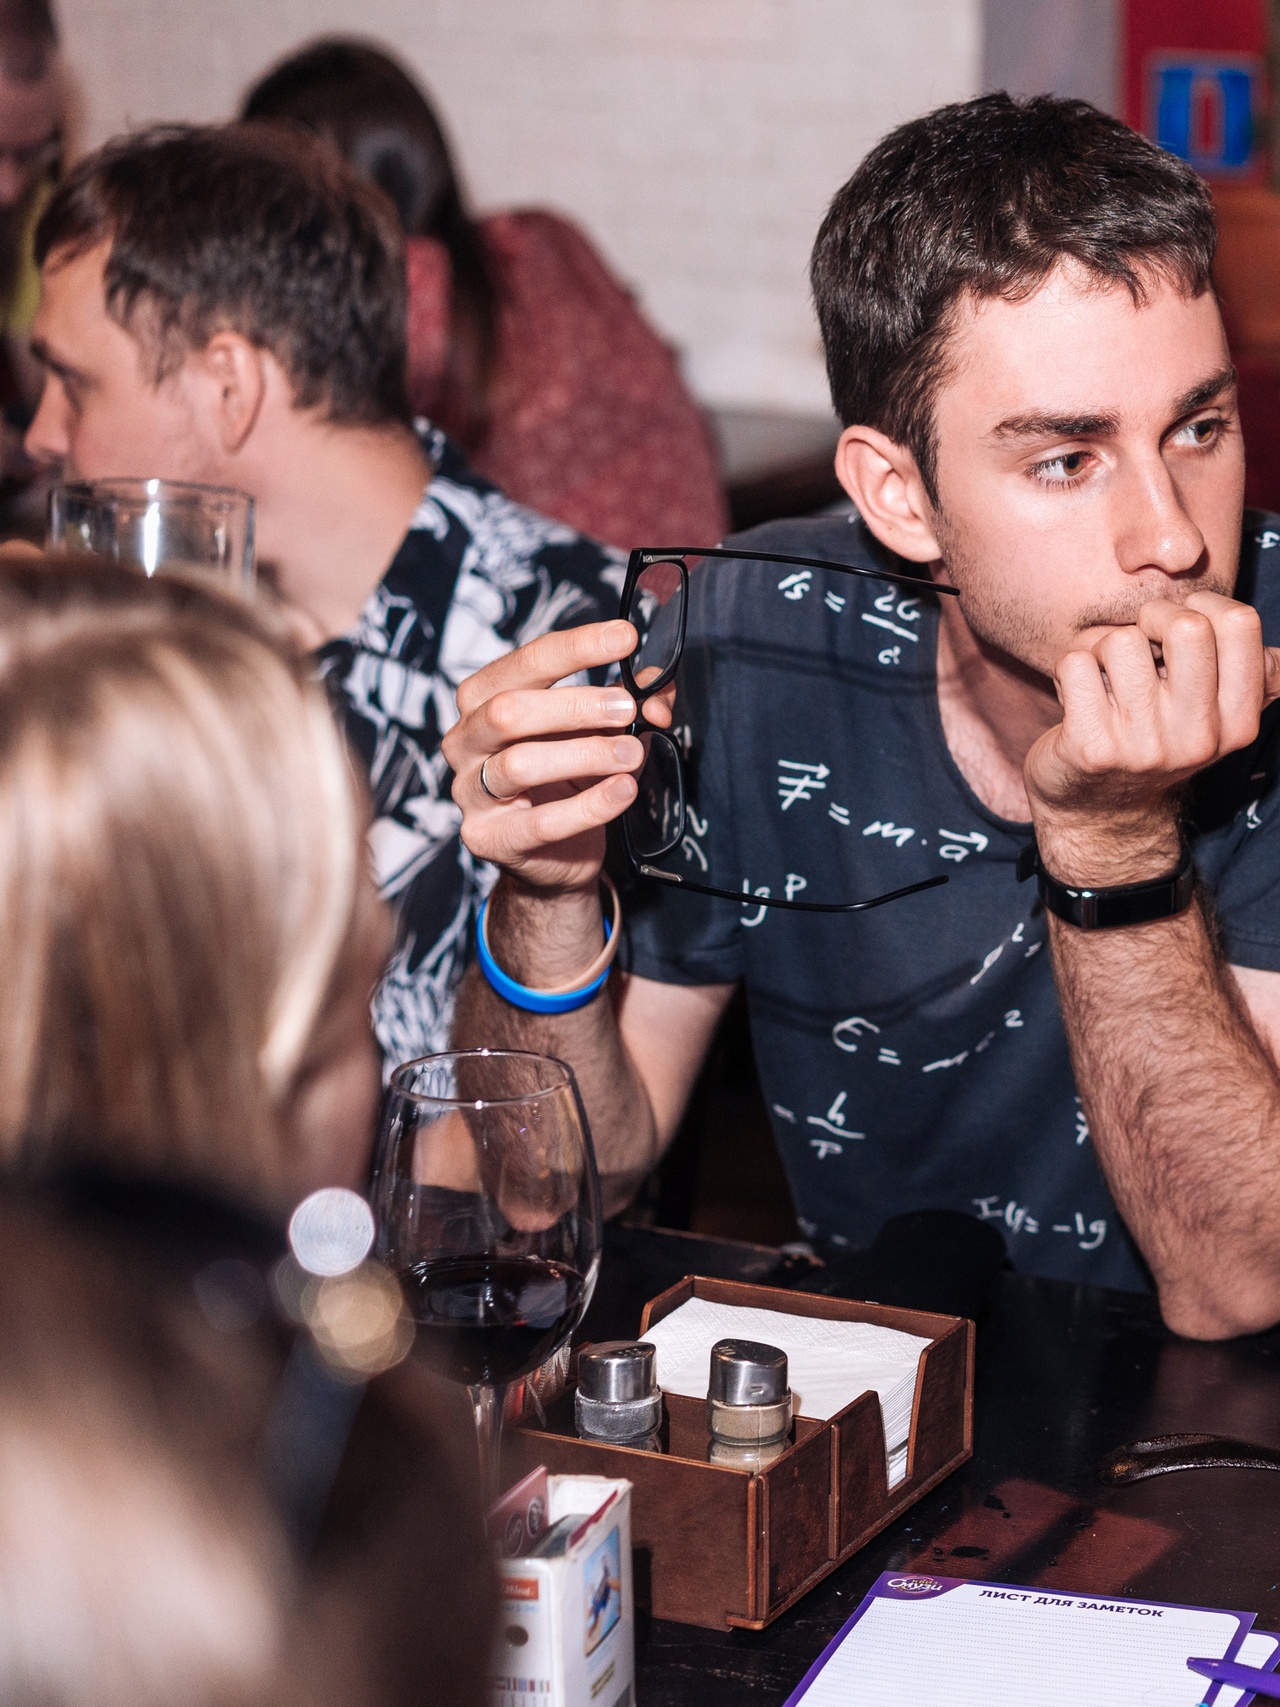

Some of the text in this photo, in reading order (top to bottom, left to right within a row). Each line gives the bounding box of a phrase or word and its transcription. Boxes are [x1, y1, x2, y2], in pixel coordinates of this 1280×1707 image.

[979, 1590, 1165, 1618] ЛИСТ ДЛЯ ЗАМЕТОК
